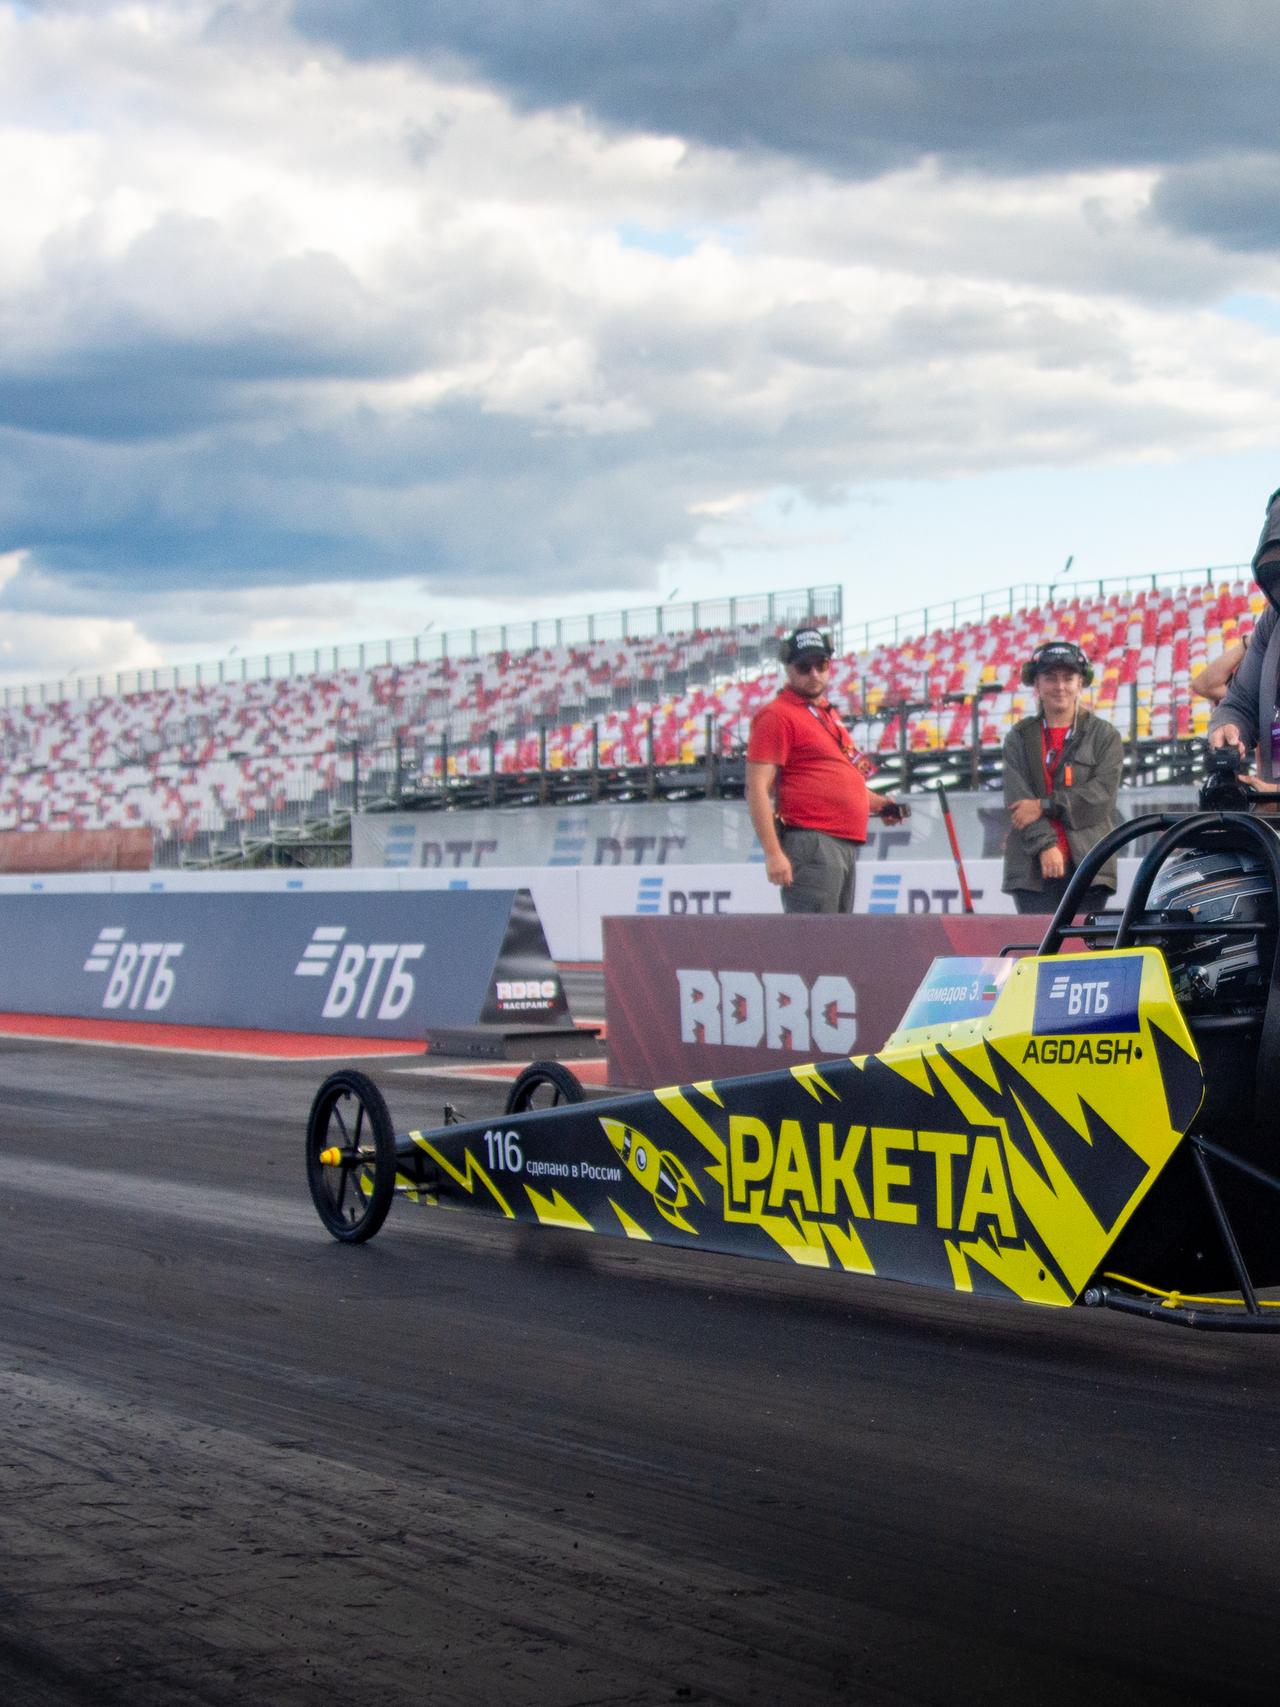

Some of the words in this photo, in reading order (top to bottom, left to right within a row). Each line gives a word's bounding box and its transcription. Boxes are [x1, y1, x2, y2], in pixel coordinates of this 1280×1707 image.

[102, 943, 184, 1011] ВТБ
[321, 944, 426, 1020] ВТБ
[496, 981, 556, 999] RDRC
[503, 1001, 550, 1010] RACEPARK
[675, 968, 857, 1055] RDRC
[1068, 981, 1110, 1015] ВТБ
[1021, 1039, 1133, 1065] AGDASH
[484, 1130, 522, 1172] 116
[526, 1160, 569, 1177] сделано
[571, 1164, 578, 1178] в
[581, 1162, 621, 1182] России
[728, 1114, 1018, 1239] РАКЕТА
